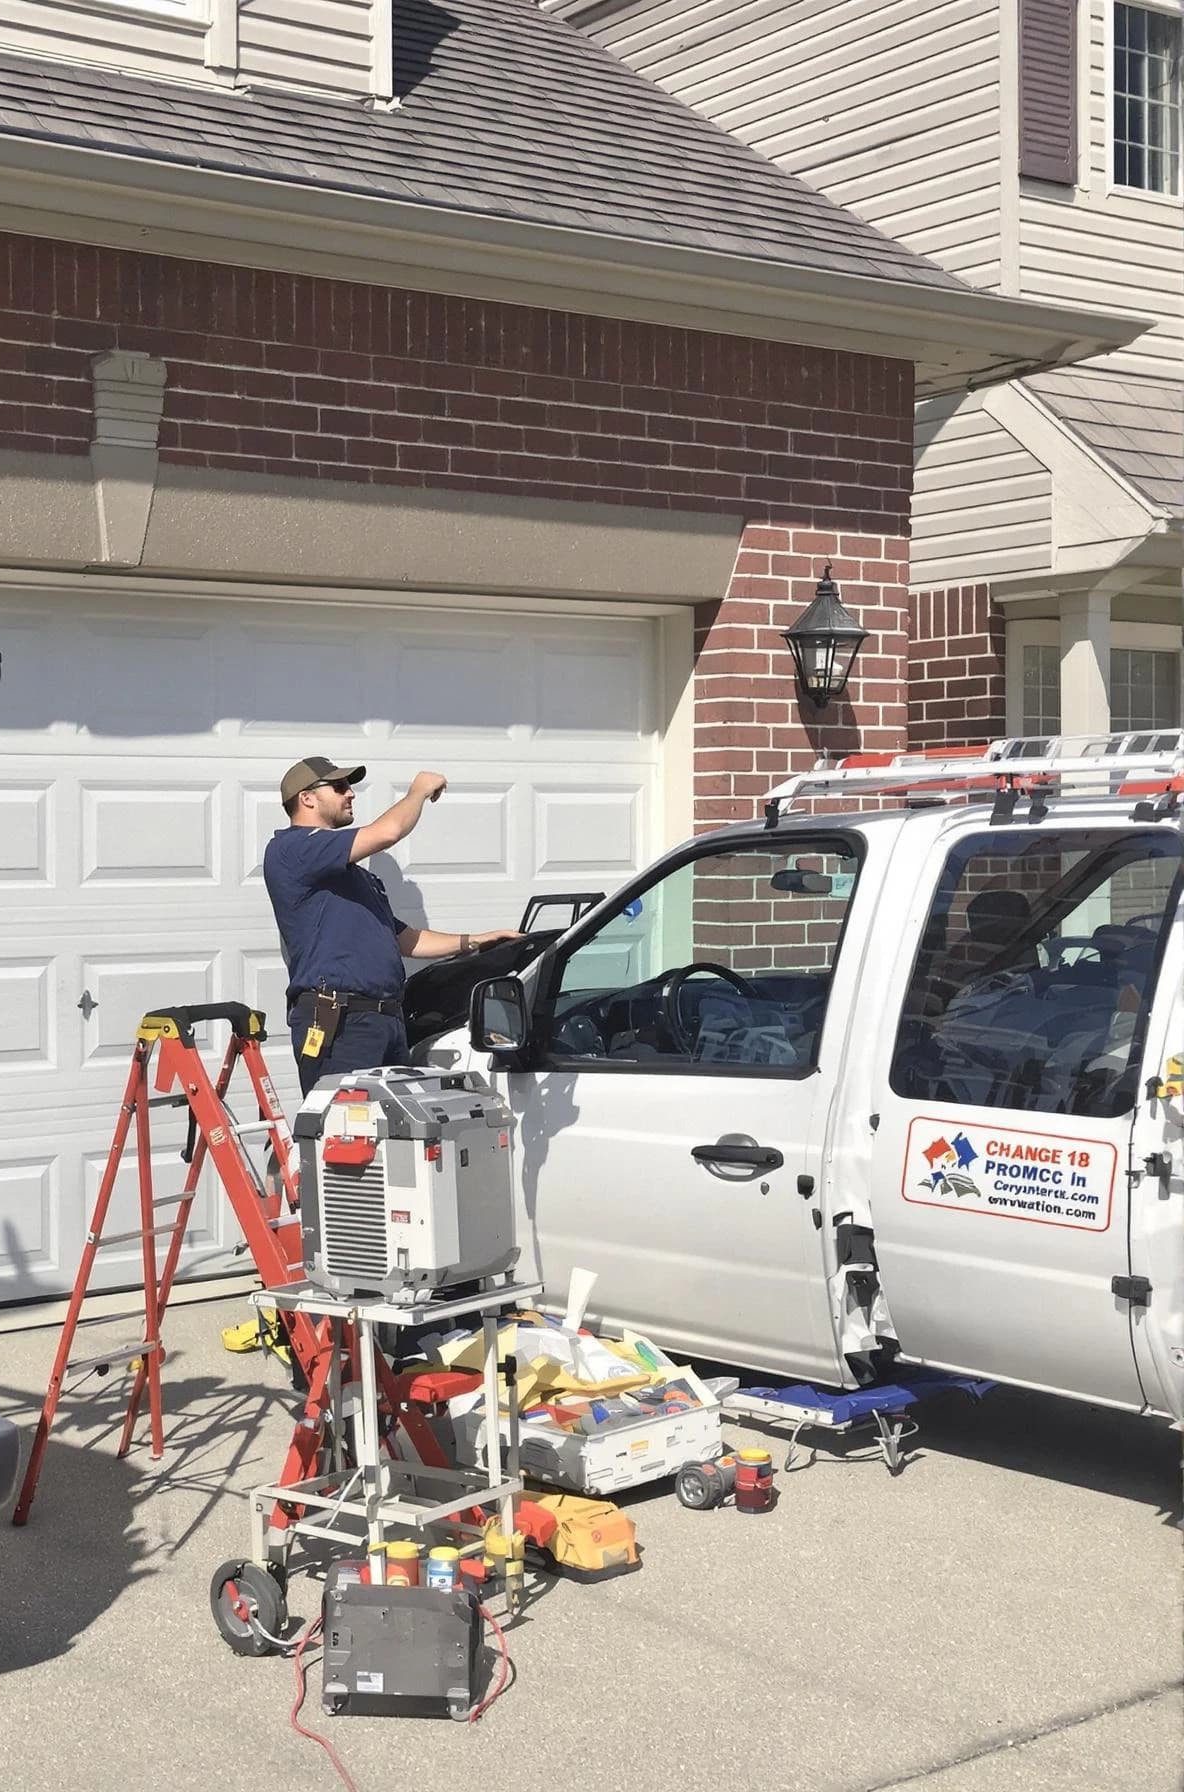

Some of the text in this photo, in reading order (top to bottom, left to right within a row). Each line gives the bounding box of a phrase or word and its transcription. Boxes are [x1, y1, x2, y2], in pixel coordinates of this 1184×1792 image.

[986, 1140, 1090, 1168] CHANGE 18
[985, 1160, 1063, 1184] PROMCC
